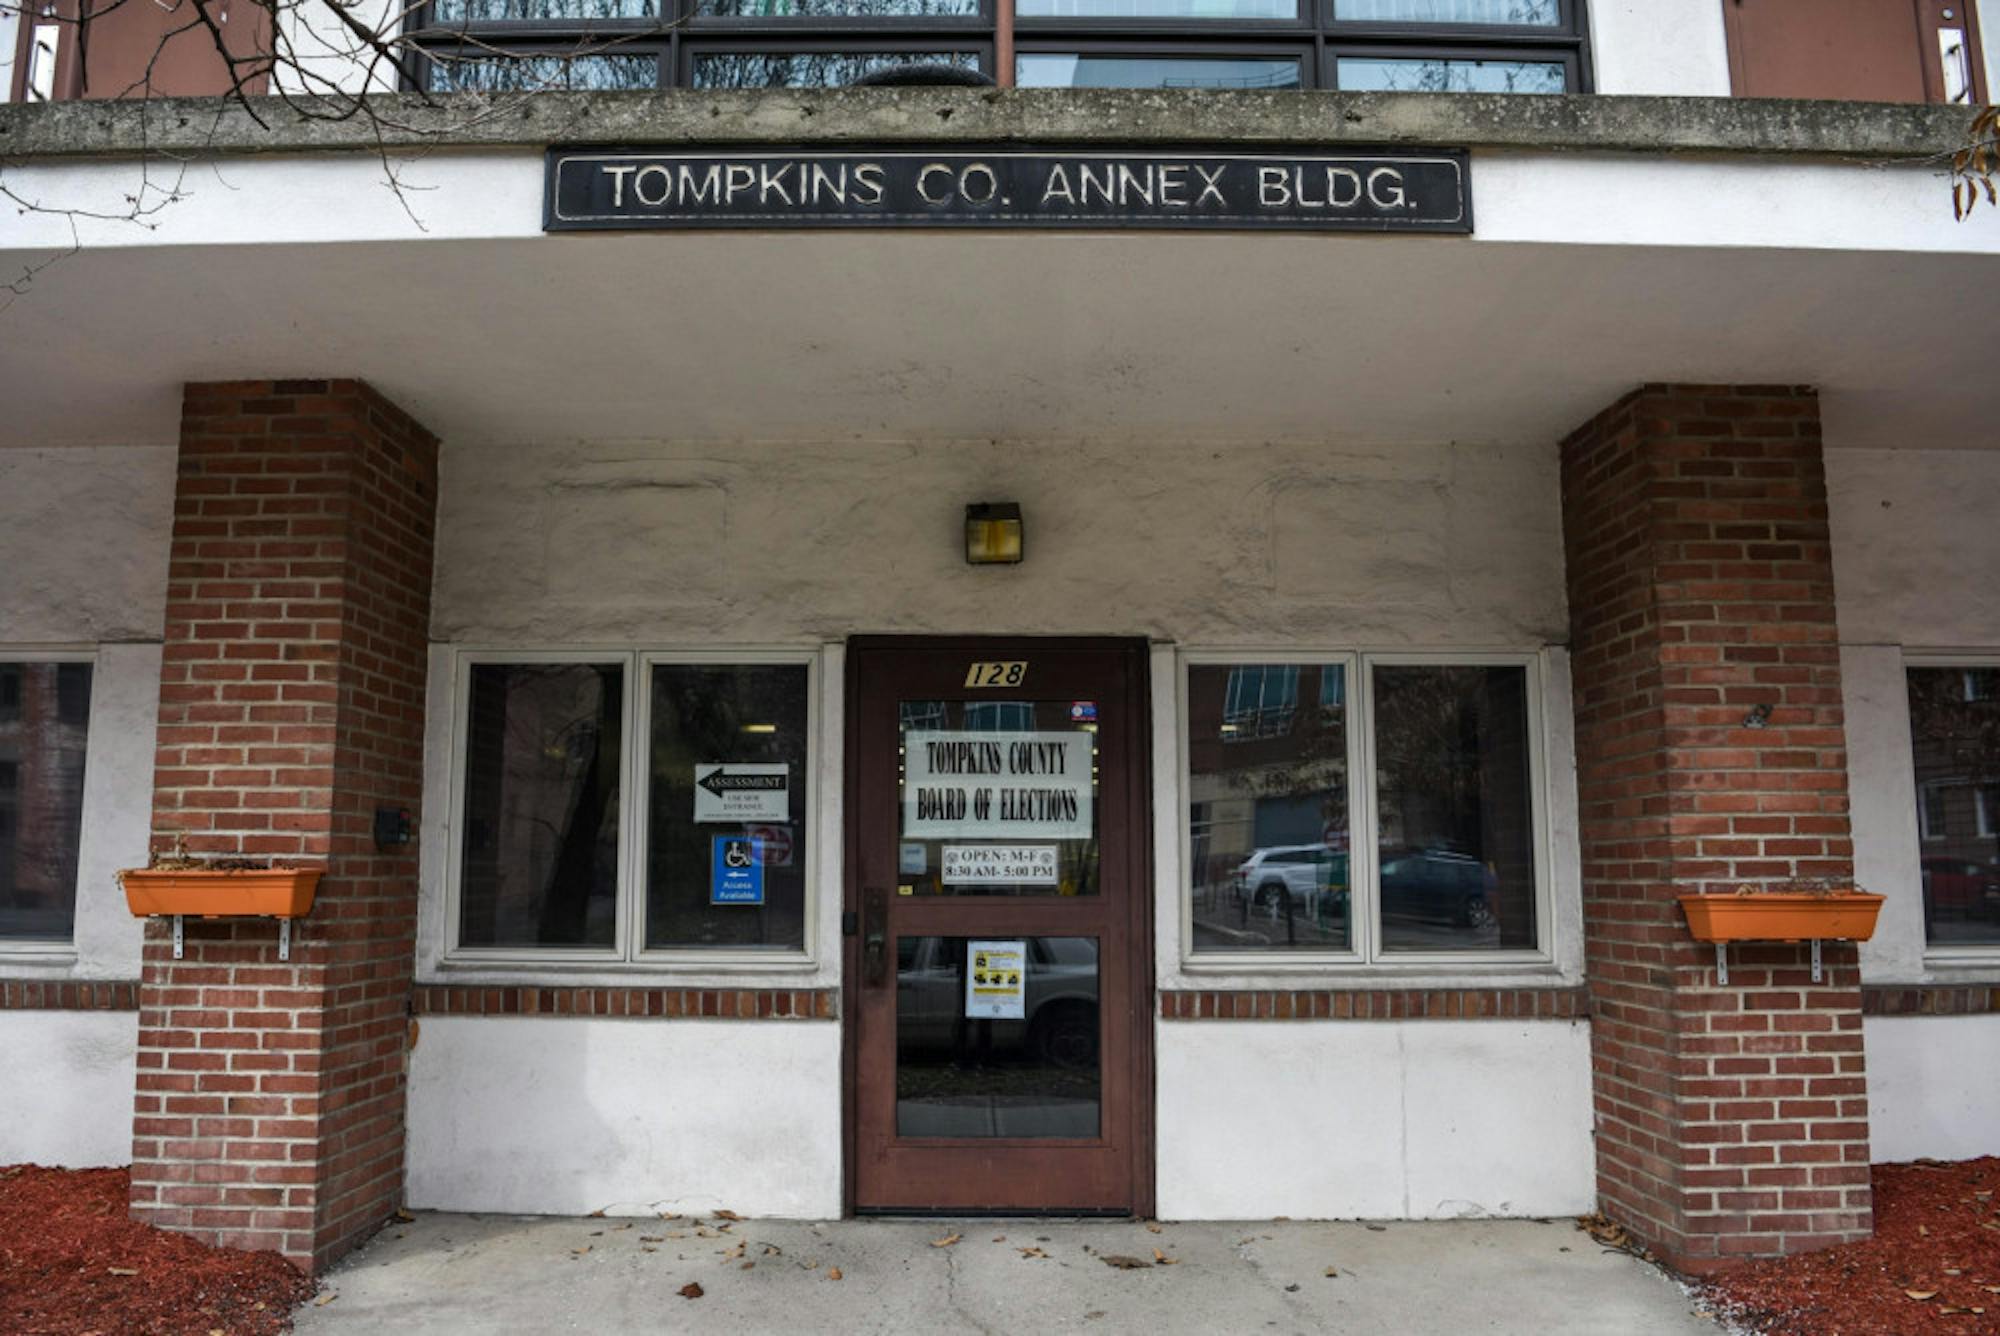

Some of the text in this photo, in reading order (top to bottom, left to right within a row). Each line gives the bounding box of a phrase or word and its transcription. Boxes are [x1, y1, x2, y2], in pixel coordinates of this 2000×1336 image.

[602, 162, 1418, 208] TOMPKINS CO. ANNEX BLDG.
[974, 663, 1023, 685] 128
[926, 741, 1068, 775] TOMPKINS COUNTY
[707, 776, 780, 788] ASSESSMENT
[917, 787, 1078, 822] BOARD OF ELECTIONS
[961, 850, 1037, 862] OPEN: M-F
[945, 866, 971, 877] 8:30
[1003, 865, 1029, 877] 5:00
[1033, 866, 1053, 877] PM
